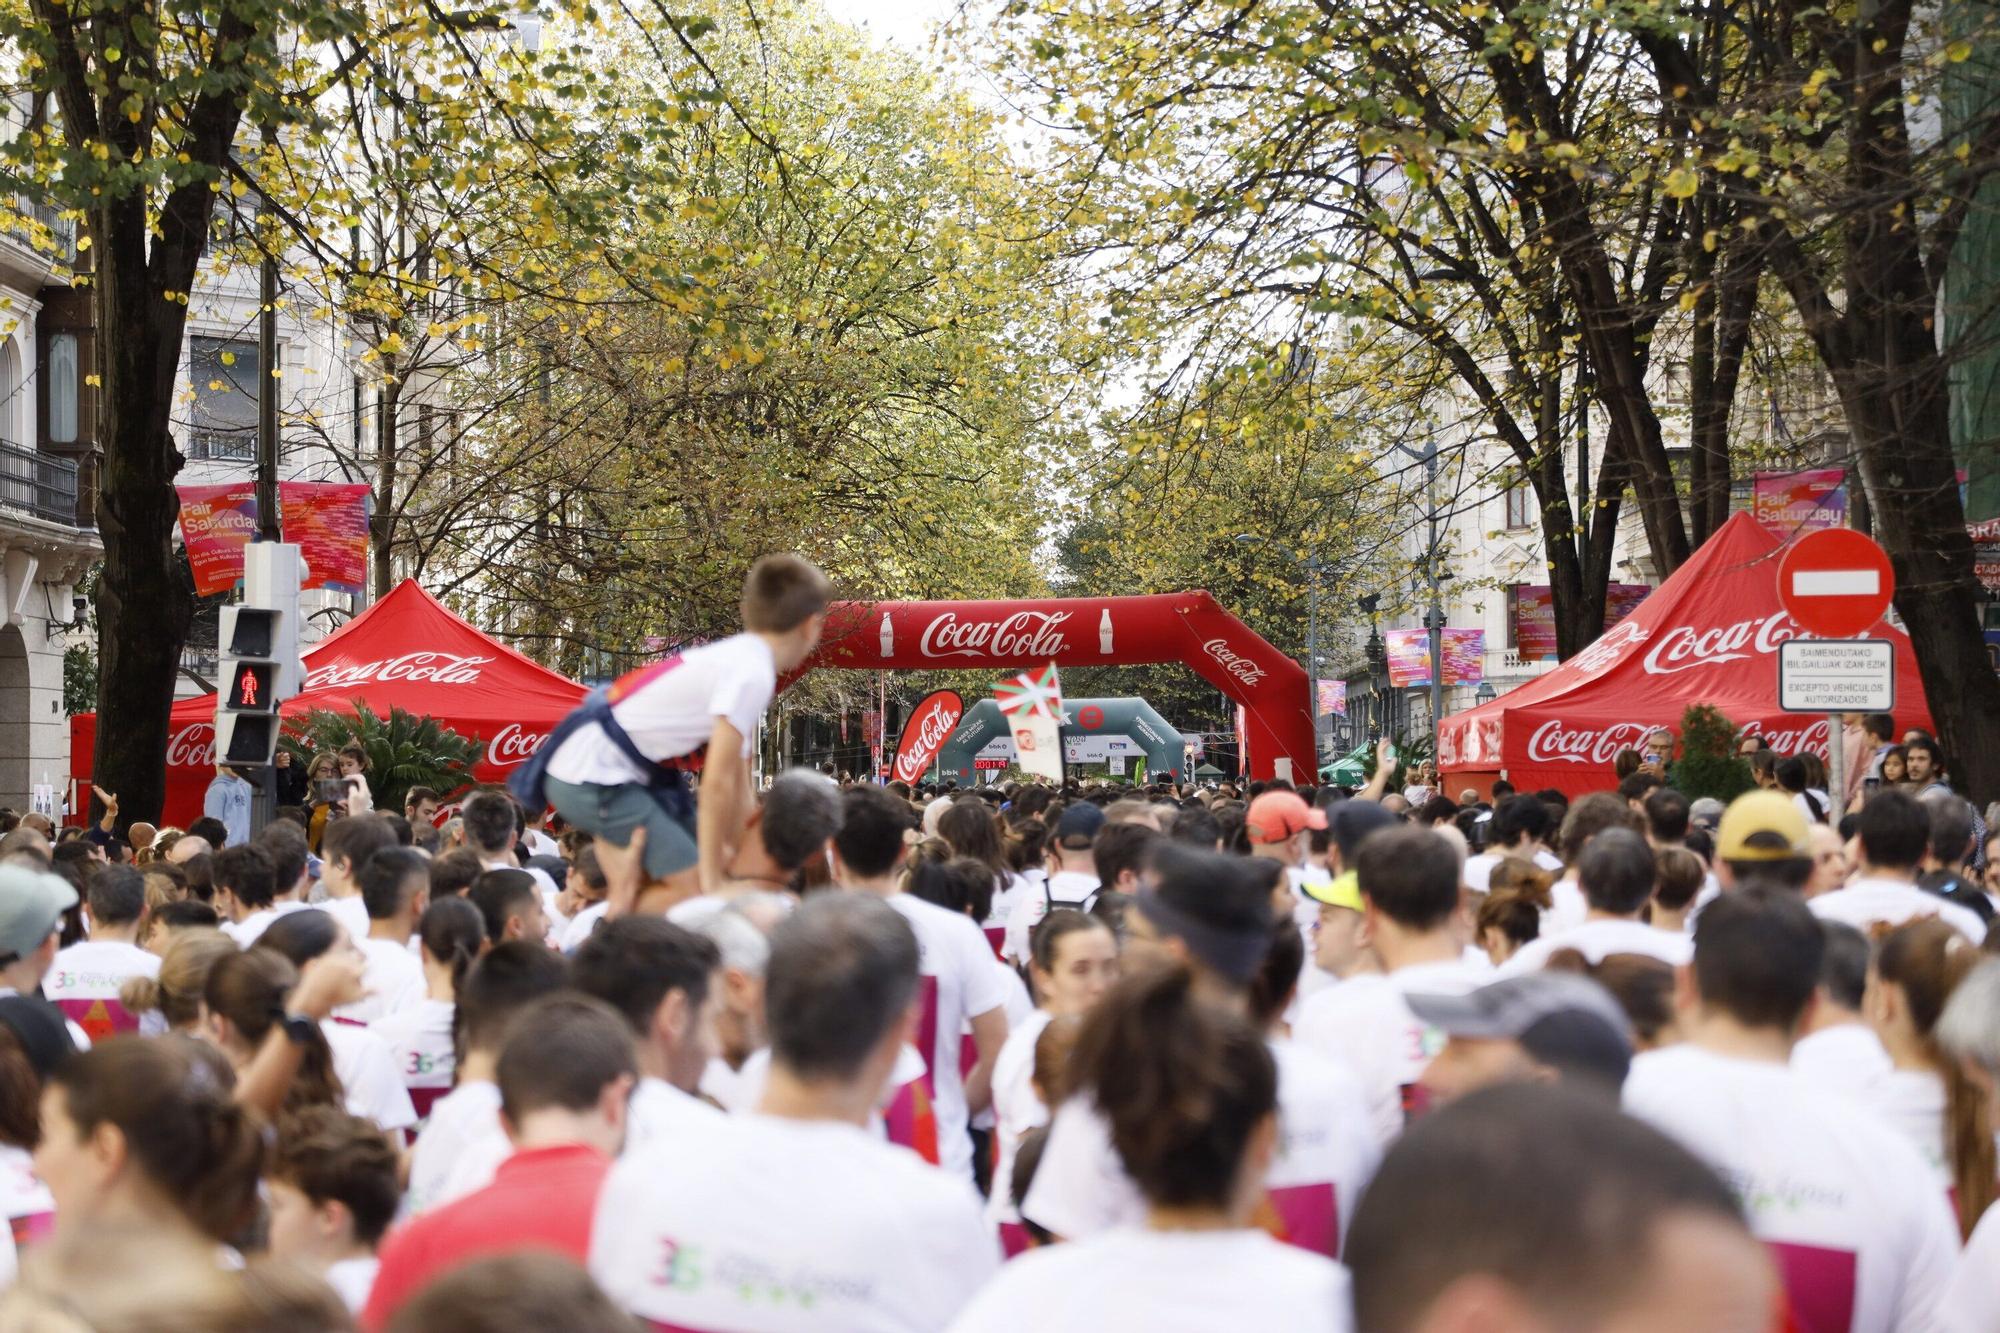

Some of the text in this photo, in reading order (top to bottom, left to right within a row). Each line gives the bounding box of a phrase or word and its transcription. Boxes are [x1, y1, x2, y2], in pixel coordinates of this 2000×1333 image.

[180, 501, 212, 517] Fair
[1757, 492, 1791, 507] Fair
[185, 513, 258, 533] Saturday
[1757, 507, 1841, 527] Saturday
[920, 611, 1073, 657] Coca-Cola
[1800, 648, 1872, 657] BAIMENDUTAKO
[1203, 639, 1268, 687] Coca-Cola
[1788, 682, 1884, 692] EXCEPTO VEHÍCULOS
[1803, 695, 1869, 704] AUTORIZADOS
[897, 699, 953, 781] Coca-Cola
[1528, 720, 1668, 764] Coca-Col
[407, 1051, 433, 1075] 36
[650, 1237, 704, 1290] 36
